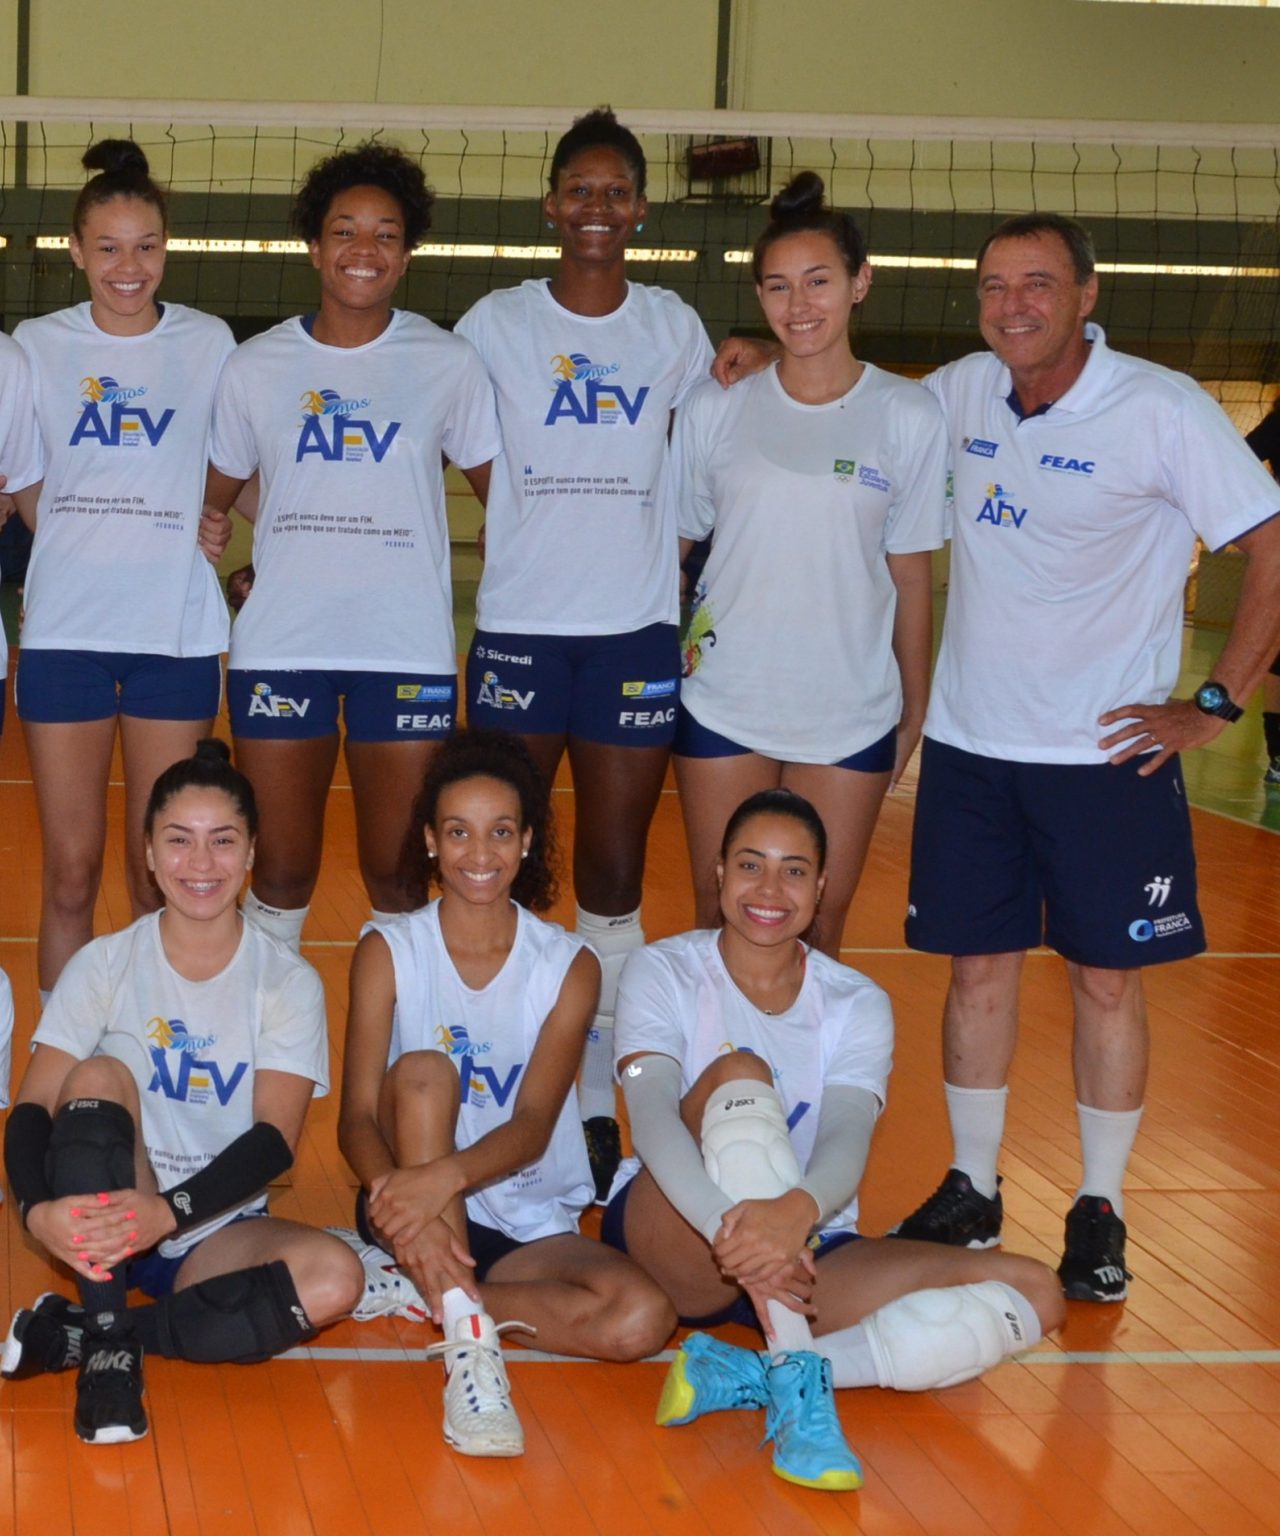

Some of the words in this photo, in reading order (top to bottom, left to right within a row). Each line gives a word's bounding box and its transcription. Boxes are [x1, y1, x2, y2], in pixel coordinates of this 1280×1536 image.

[544, 378, 650, 426] AFV
[69, 401, 176, 446] AFV
[296, 413, 402, 463] AFV
[1040, 455, 1095, 473] FEAC
[976, 498, 1028, 528] AFV
[487, 649, 532, 665] Sicredi
[248, 695, 310, 717] AFV
[477, 682, 535, 710] AFV
[397, 714, 451, 728] FEAC
[619, 708, 675, 725] FEAC
[1154, 917, 1190, 934] FRANCA
[148, 1044, 249, 1106] AFV
[460, 1054, 523, 1107] FV
[63, 1324, 84, 1367] NIKE
[85, 1349, 135, 1374] NIKE
